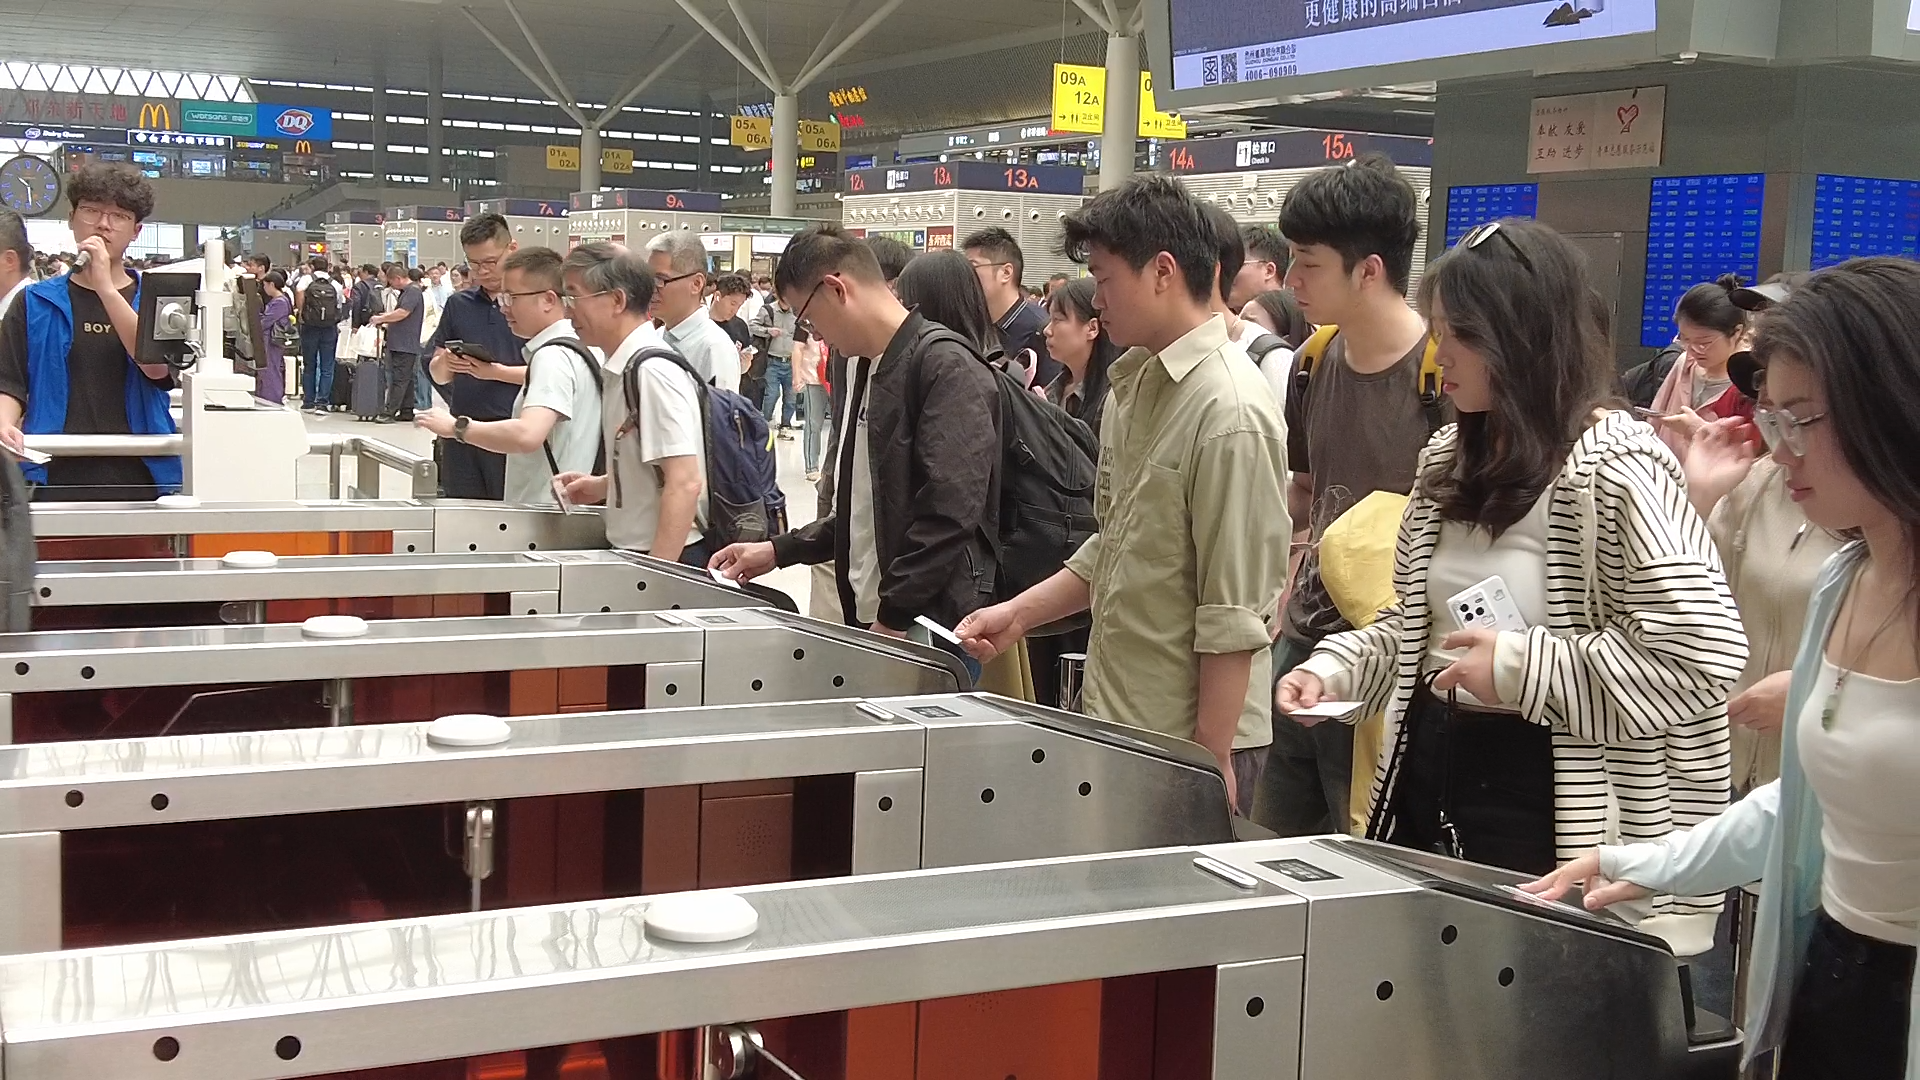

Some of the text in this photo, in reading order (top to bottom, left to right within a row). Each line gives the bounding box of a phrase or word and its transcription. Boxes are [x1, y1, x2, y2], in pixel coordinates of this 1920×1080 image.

[1305, 0, 1462, 29] 更健康的高
[1060, 71, 1087, 87] 09A
[1074, 91, 1100, 106] 12A
[282, 114, 308, 131] DQ
[735, 118, 757, 130] 05A
[805, 124, 826, 135] 05A
[746, 133, 768, 145] 06A
[816, 137, 837, 149] 06A
[550, 148, 568, 157] 01A
[1322, 133, 1354, 160] 15A
[604, 151, 621, 159] 01A
[1169, 147, 1195, 170] 14A
[559, 159, 577, 168] 02A
[613, 162, 630, 170] 02A
[850, 174, 865, 191] 12A
[933, 166, 952, 186] 13A
[1004, 168, 1039, 189] 13A
[665, 193, 685, 209] 9A
[446, 209, 461, 220] 5A
[538, 203, 554, 216] 7A
[84, 322, 111, 333] BOY
